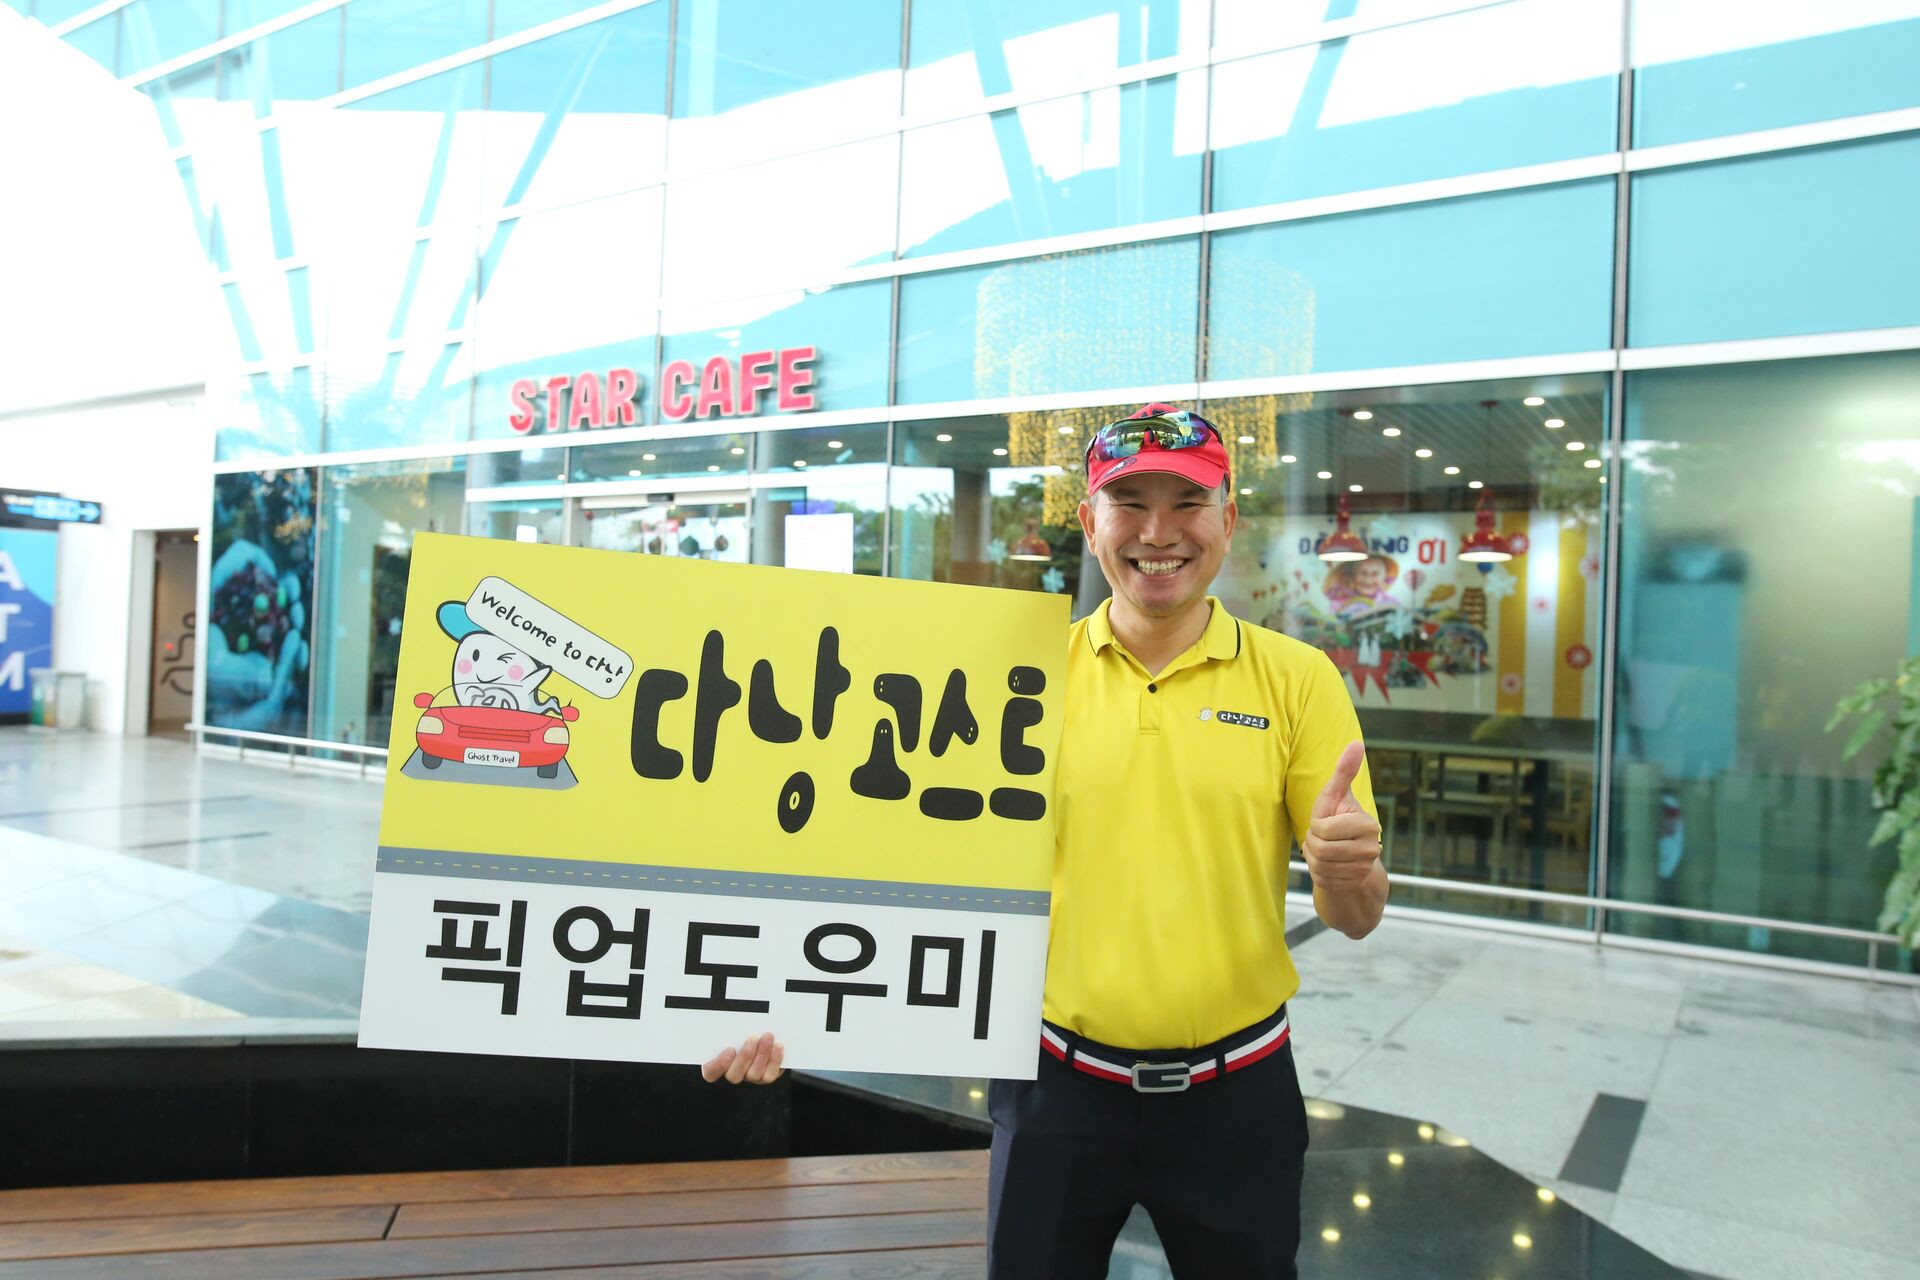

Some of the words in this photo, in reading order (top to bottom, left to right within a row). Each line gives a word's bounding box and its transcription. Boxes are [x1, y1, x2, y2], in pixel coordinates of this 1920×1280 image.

[509, 368, 638, 434] STAR
[661, 346, 816, 421] CAFE
[481, 591, 557, 647] Welcome
[563, 641, 582, 660] to
[585, 655, 624, 684] 다낭
[467, 752, 490, 762] Ghost
[492, 754, 515, 763] Travel
[631, 626, 1046, 833] 다낭고스트
[1220, 712, 1265, 728] 다낭고스트
[425, 900, 996, 1040] 픽업도우미
